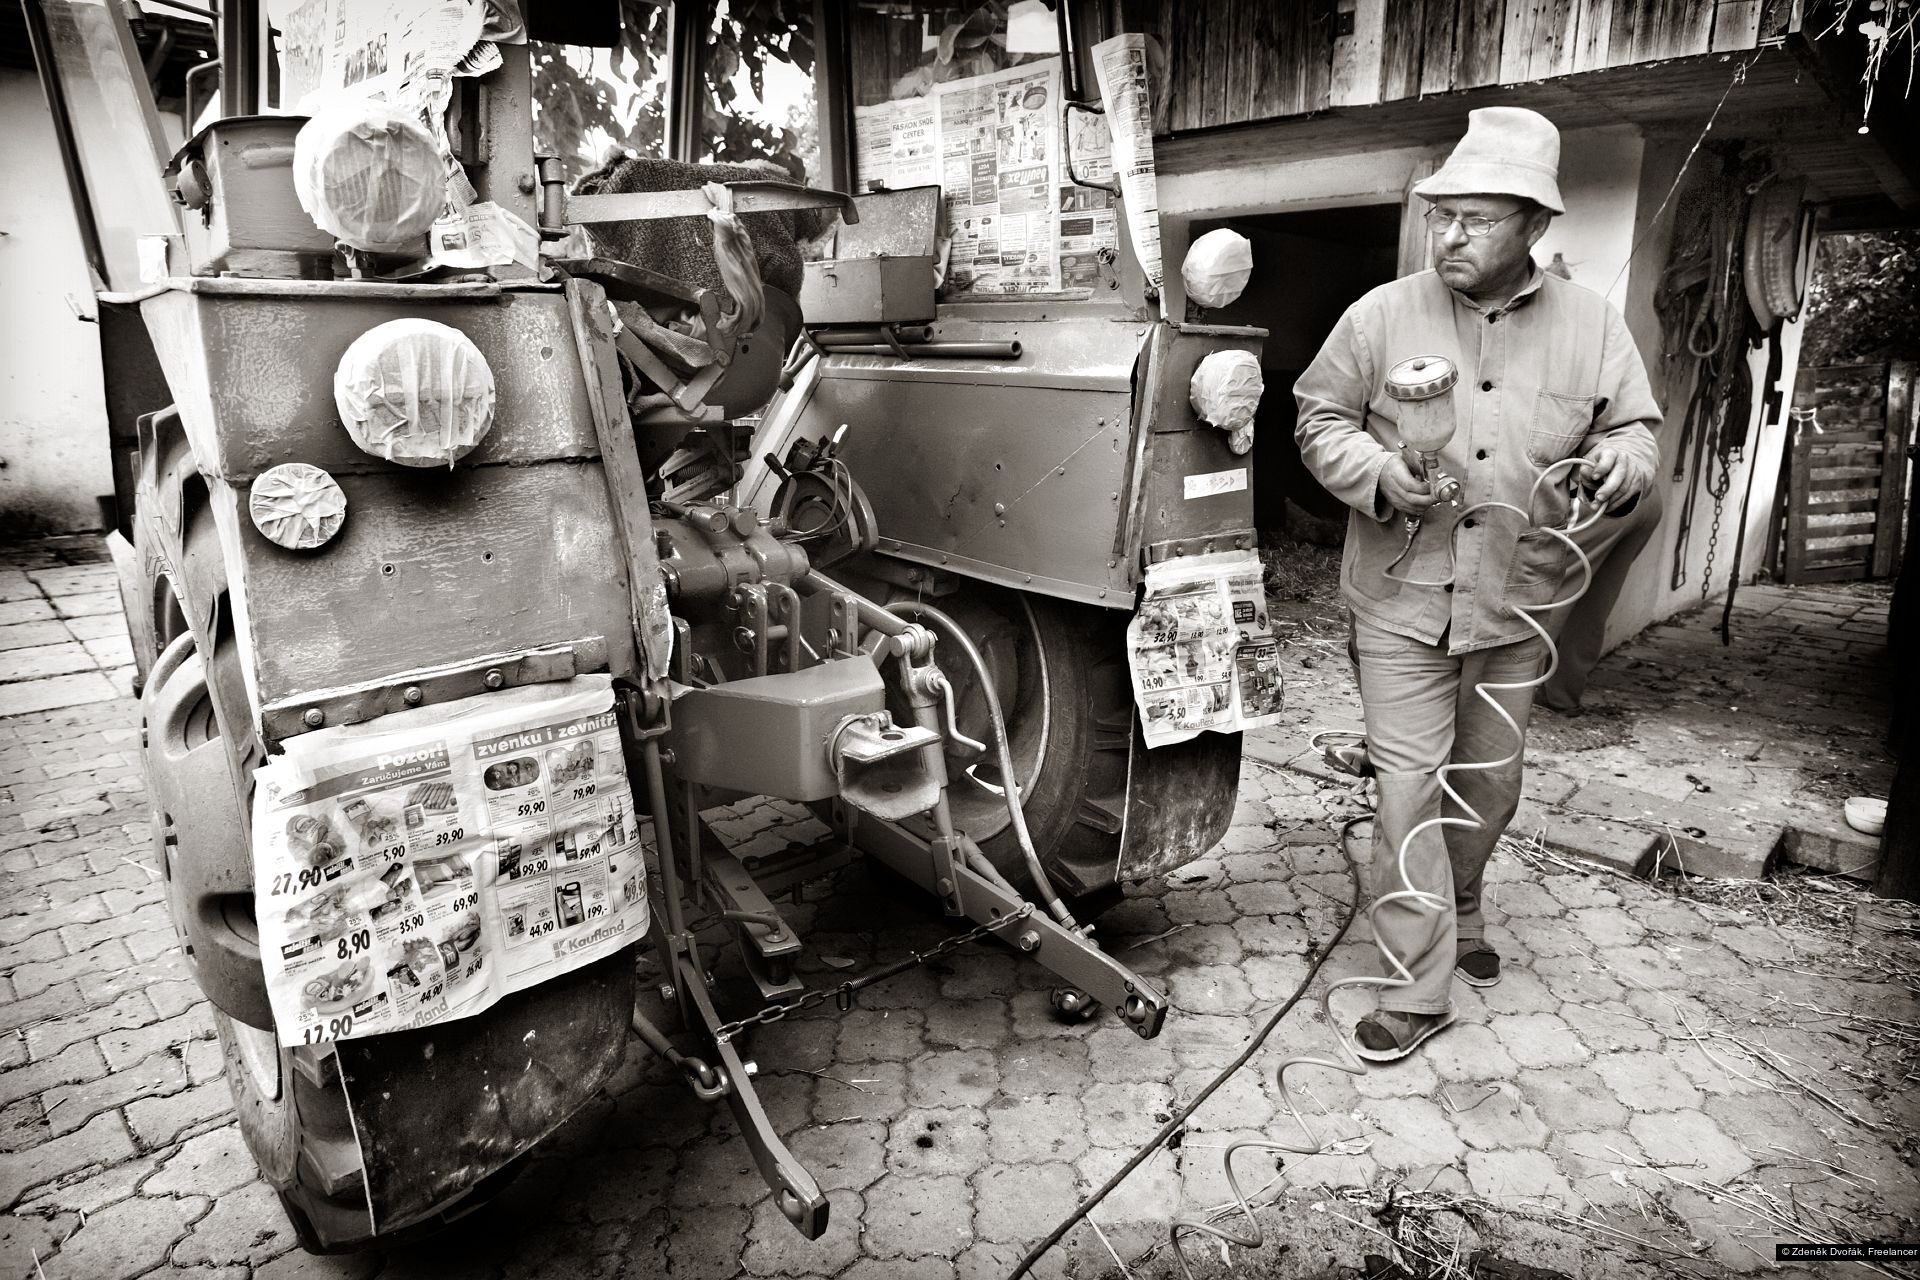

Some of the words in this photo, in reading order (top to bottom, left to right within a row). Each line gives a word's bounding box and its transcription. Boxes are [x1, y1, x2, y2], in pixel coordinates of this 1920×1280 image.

[1154, 631, 1177, 644] 32,90
[1221, 670, 1231, 679] 54,9
[477, 732, 542, 757] zvenku
[547, 727, 553, 741] i
[558, 712, 617, 739] zevnitř!
[376, 741, 444, 770] Pozor!
[361, 765, 422, 786] Zaručujeme
[424, 759, 447, 771] Vám
[573, 784, 596, 800] 79,90
[518, 800, 545, 817] 59,90
[436, 828, 464, 846] 39,90
[383, 845, 406, 862] 5,90
[580, 843, 601, 860] 59,90
[522, 859, 548, 877] 99,90
[271, 866, 322, 896] 27,90
[453, 892, 479, 912] 69,90
[587, 904, 608, 919] 199,-
[399, 914, 424, 934] 35,90
[529, 920, 554, 938] 44,90
[568, 919, 625, 951] Kaufland
[337, 929, 371, 960] 8,90
[303, 1015, 352, 1045] 17,90
